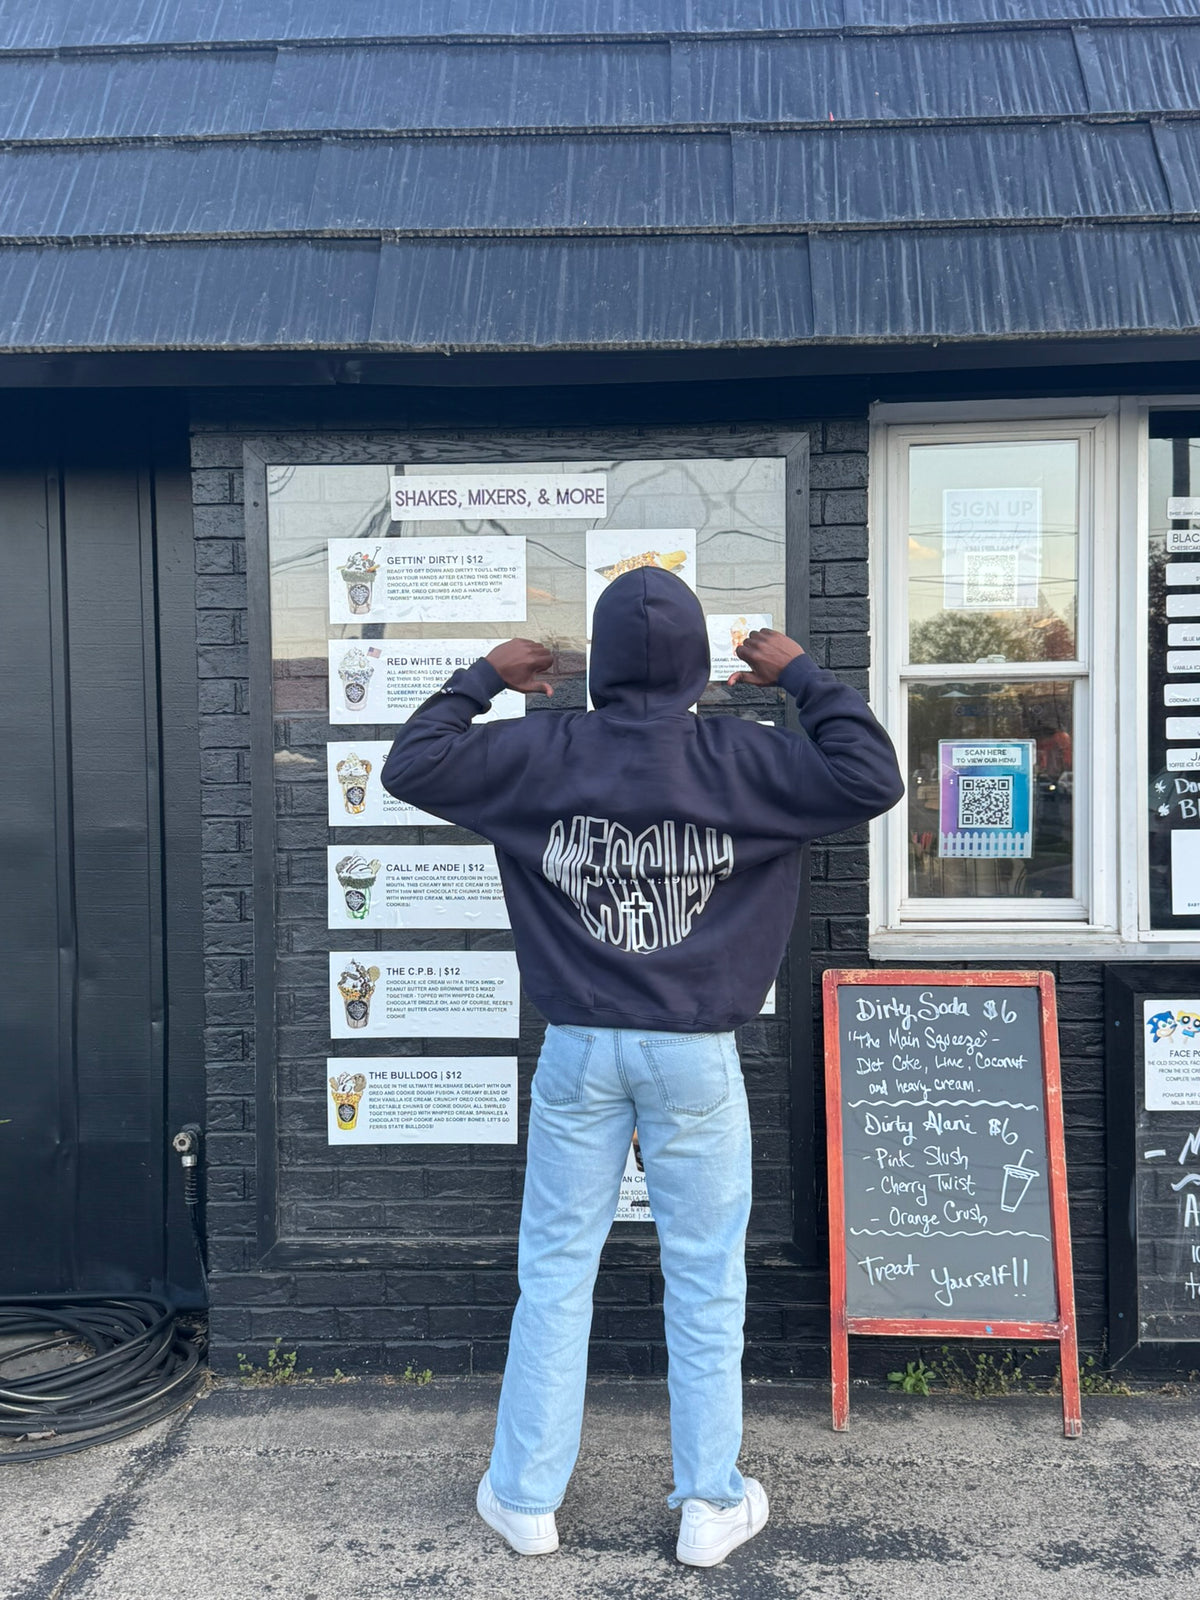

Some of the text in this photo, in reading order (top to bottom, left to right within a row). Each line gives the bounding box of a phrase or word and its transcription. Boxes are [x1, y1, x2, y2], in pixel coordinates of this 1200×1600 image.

[394, 487, 605, 508] SHAKES, MIXERS, & MORE
[950, 500, 1034, 517] SIGN UP
[386, 556, 426, 565] GETTIN'
[427, 556, 458, 564] DIRTY
[465, 555, 484, 564] $12
[386, 657, 480, 666] RED WHITE & BLU
[385, 864, 412, 872] CALL
[414, 864, 430, 872] ME
[431, 864, 460, 872] ANDE
[466, 864, 485, 872] $12
[385, 967, 406, 976] THE
[407, 967, 436, 976] C.P.B.
[443, 967, 462, 976] $12
[856, 991, 1018, 1030] Dirty Soda $6
[888, 1027, 920, 1049] Main
[856, 1057, 884, 1075] Diet
[892, 1054, 928, 1074] Coke,
[975, 1052, 1028, 1070] Coconut
[1169, 1049, 1191, 1058] FACE
[368, 1072, 388, 1080] THE
[389, 1071, 438, 1080] BULLDOG
[444, 1071, 463, 1080] $12
[868, 1078, 981, 1101] and heavy cream.
[864, 1110, 1018, 1146] Dirty Alani $6
[875, 1145, 969, 1170] Pink Slush
[881, 1173, 976, 1206] Cherry Twist
[889, 1200, 988, 1234] Orange Crush
[858, 1254, 1028, 1306] Treat Yourself!!
